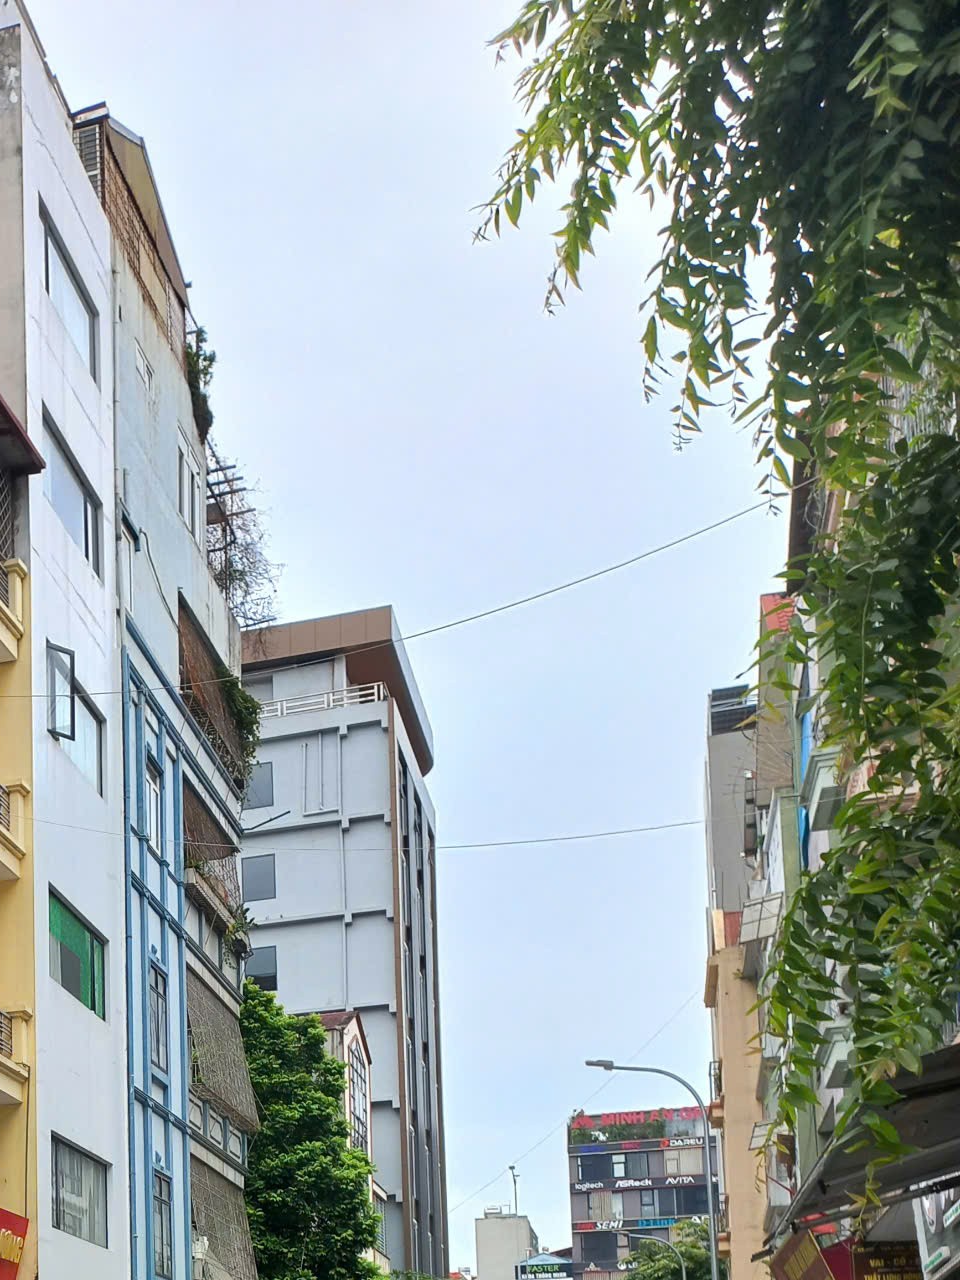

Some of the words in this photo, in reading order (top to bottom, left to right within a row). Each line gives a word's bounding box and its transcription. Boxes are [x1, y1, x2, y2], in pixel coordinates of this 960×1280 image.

[601, 1112, 645, 1126] MINH
[649, 1109, 674, 1122] AN
[665, 1175, 696, 1185] AVITA
[574, 1181, 604, 1191] logitech
